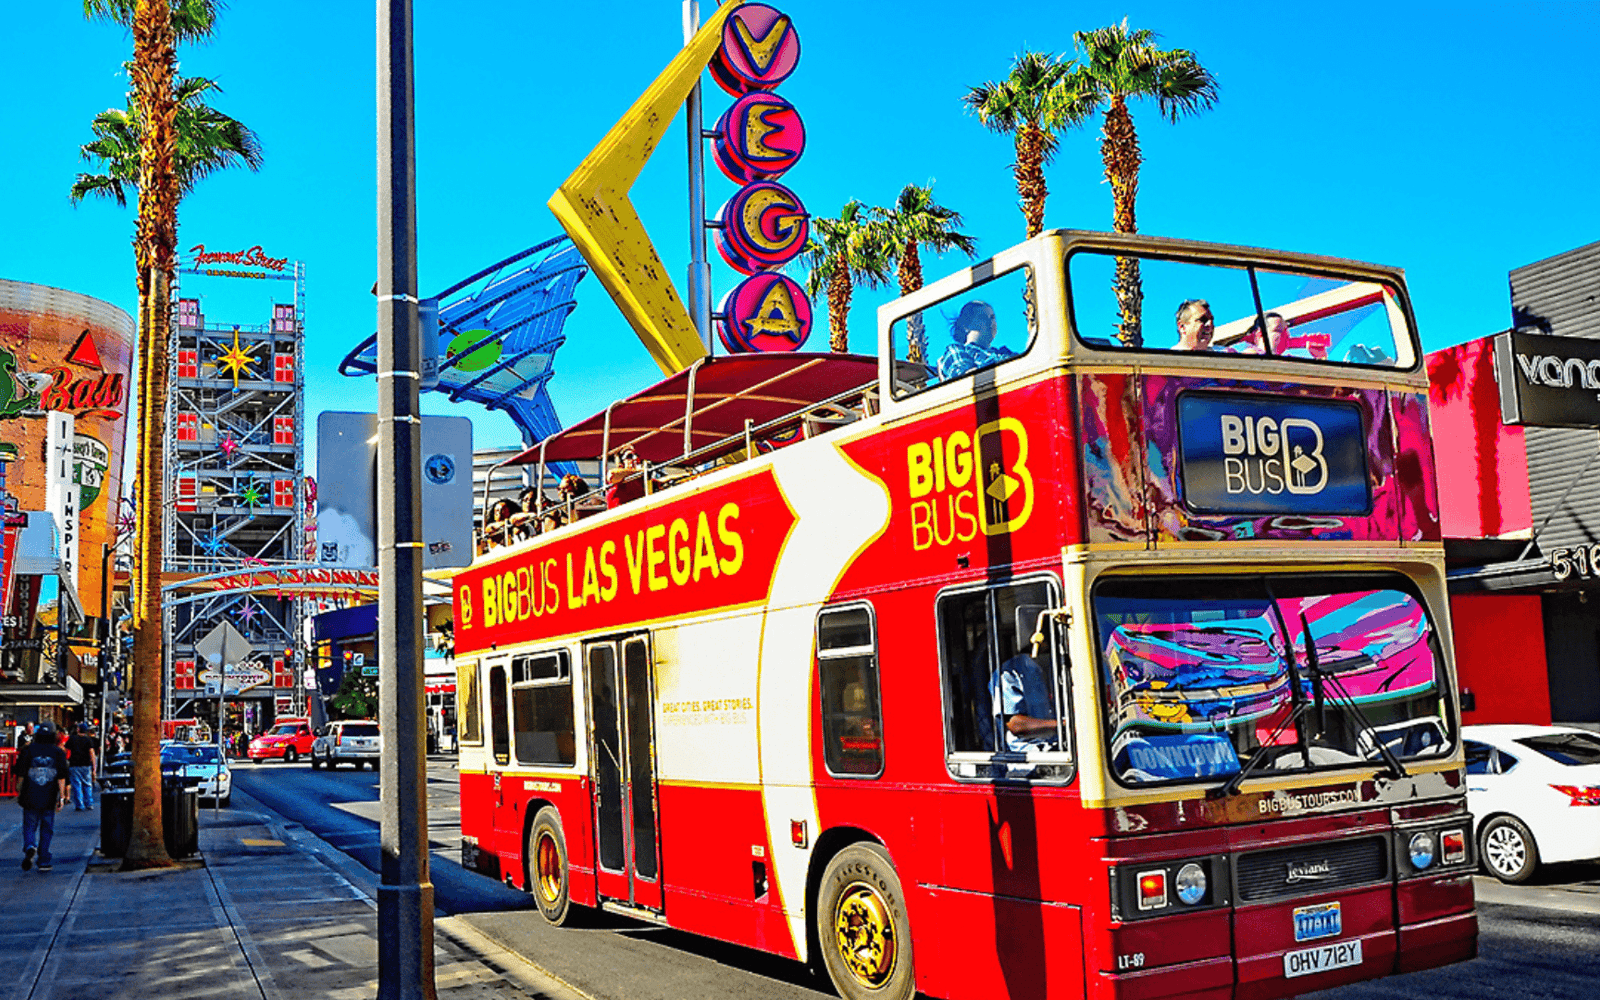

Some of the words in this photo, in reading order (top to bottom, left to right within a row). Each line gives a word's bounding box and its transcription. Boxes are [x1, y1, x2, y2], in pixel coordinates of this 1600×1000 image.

[189, 244, 245, 271] Fremont
[242, 245, 288, 271] Street
[40, 366, 124, 411] Bass
[1221, 414, 1280, 456] BIG
[907, 430, 974, 498] BIG
[1223, 457, 1284, 495] BUS
[910, 490, 978, 551] BUS
[566, 538, 618, 610] LAS
[624, 502, 744, 596] VEGAS
[1285, 859, 1331, 883] Leyland
[1289, 951, 1320, 973] OHV
[1322, 942, 1358, 967] 712Y
